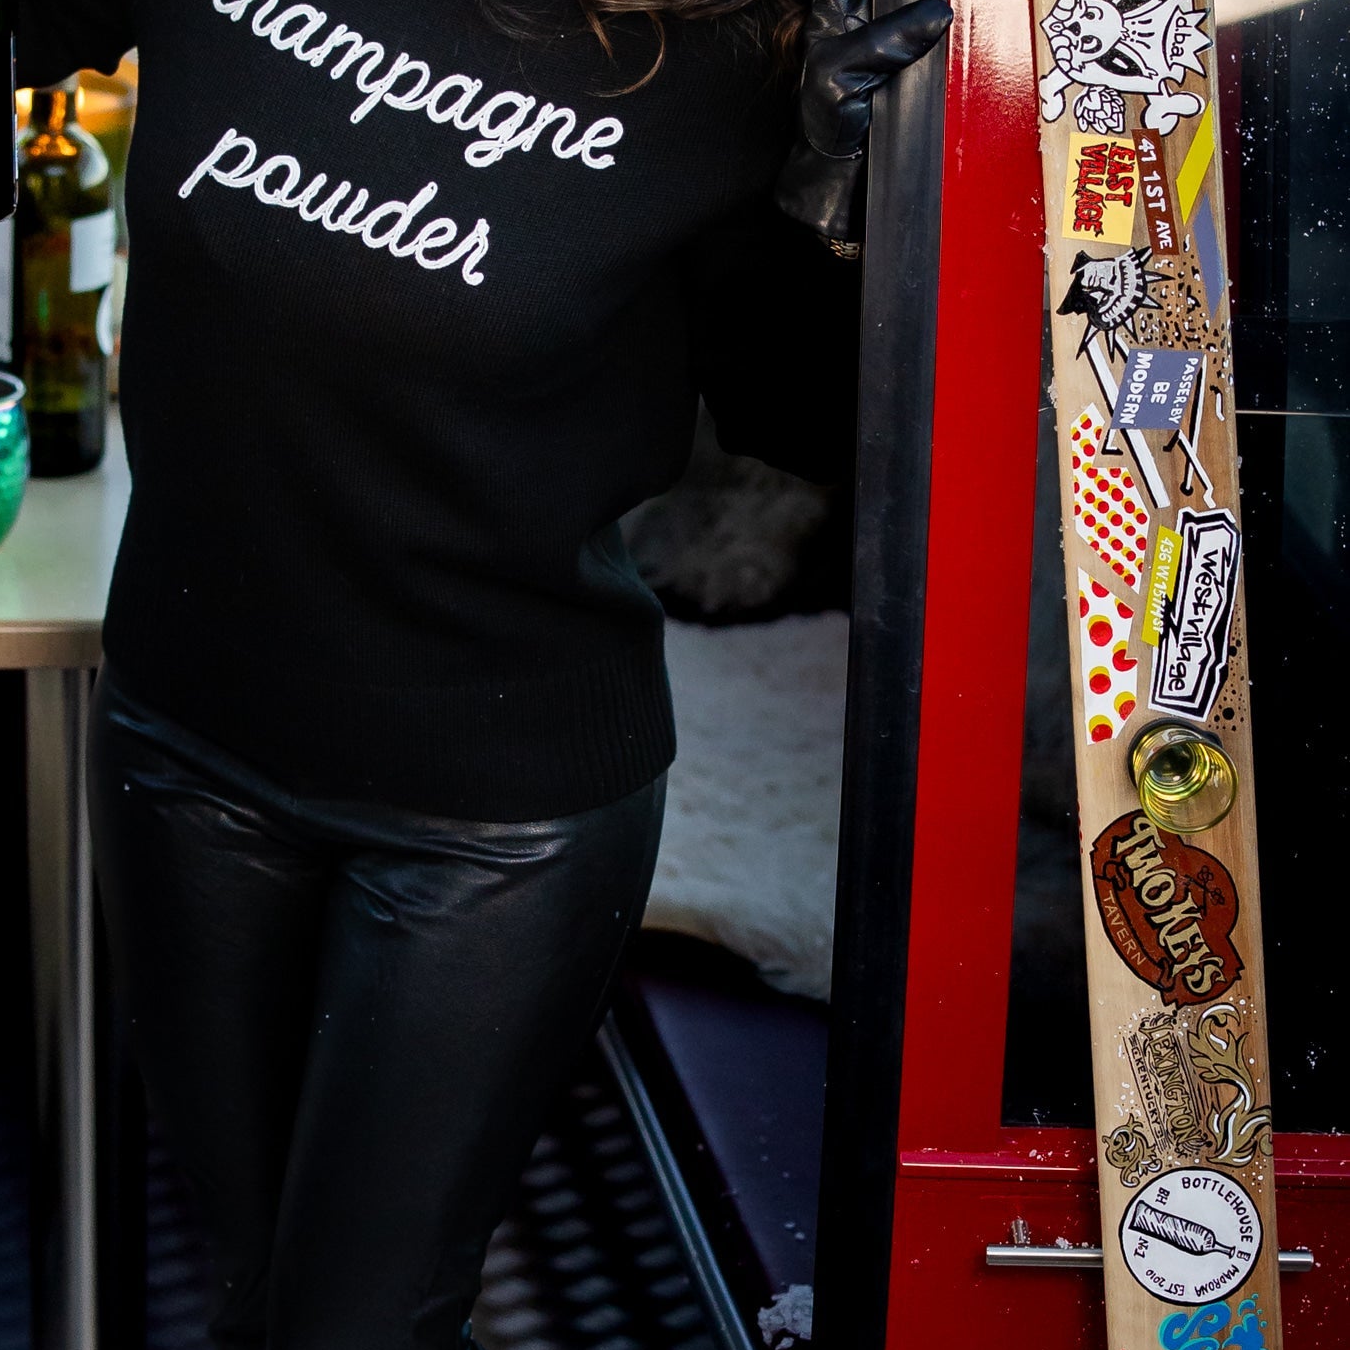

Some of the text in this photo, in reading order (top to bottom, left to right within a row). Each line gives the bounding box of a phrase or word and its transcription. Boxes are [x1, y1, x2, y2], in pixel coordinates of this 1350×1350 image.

[178, 128, 490, 286] powder
[1073, 141, 1109, 237] VILLAGE
[1104, 141, 1136, 208] EAST
[1136, 138, 1172, 250] 41 1ST AVE
[1119, 351, 1153, 426] MODERN
[1150, 380, 1171, 405] BE
[1159, 537, 1174, 563] 436
[1105, 891, 1146, 966] TAVERN
[1135, 1055, 1161, 1128] KENTUCKY
[1155, 1186, 1170, 1206] BH
[1182, 1176, 1253, 1243] BOTTLEHOUSE
[1146, 1268, 1185, 1297] EST 2010
[1195, 1264, 1240, 1297] MADRONA
